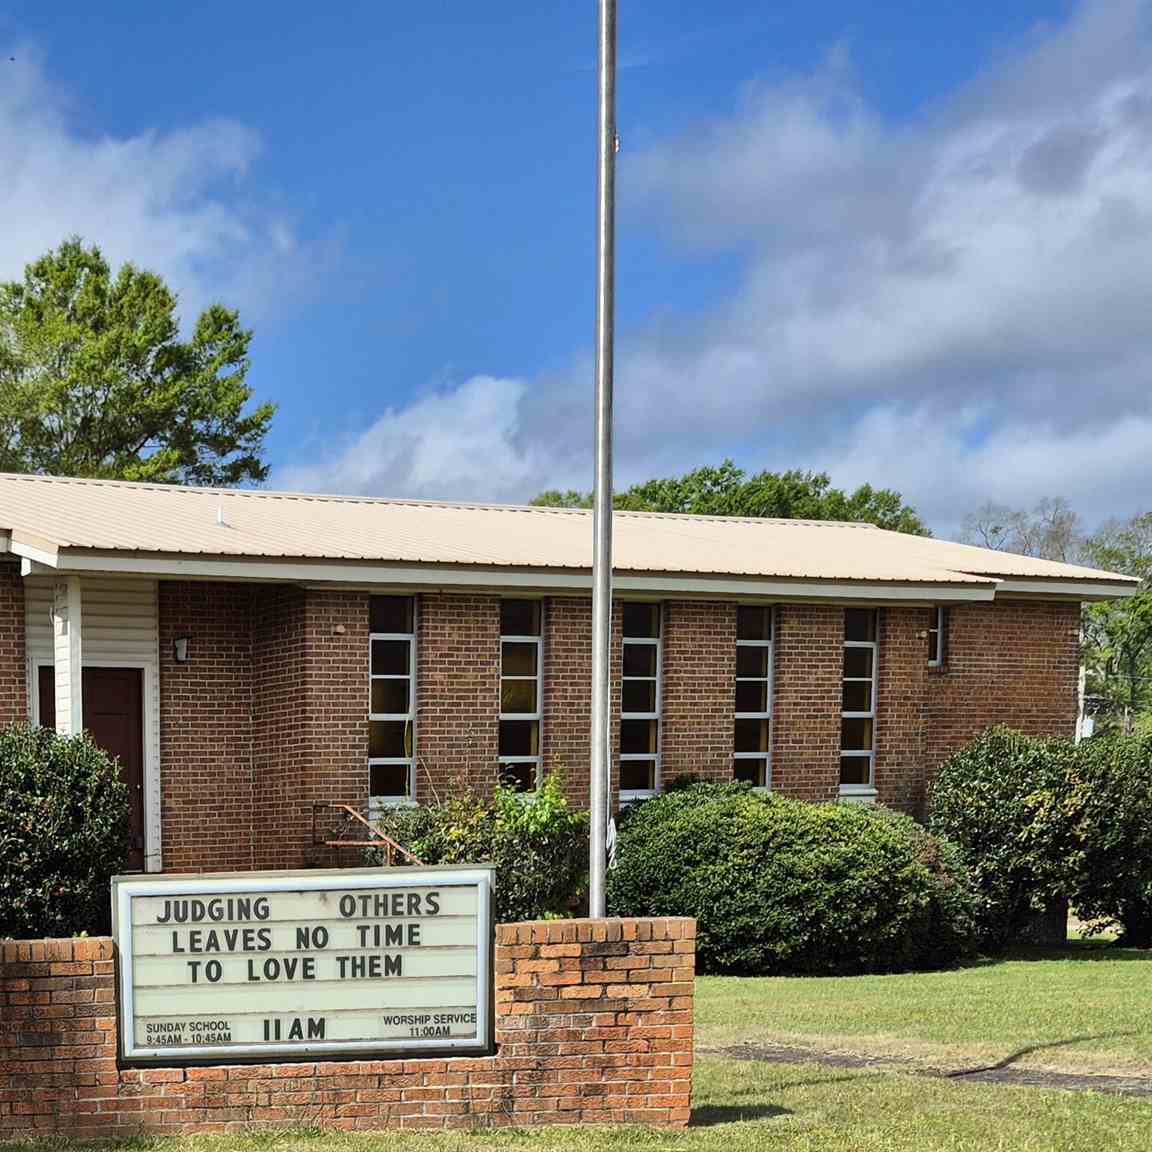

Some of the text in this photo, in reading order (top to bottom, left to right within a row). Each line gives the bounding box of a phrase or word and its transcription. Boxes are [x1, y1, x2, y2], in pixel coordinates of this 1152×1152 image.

[156, 891, 441, 923] JUDGING OTHERS
[173, 924, 421, 953] LEAVES NO TIME
[188, 954, 403, 983] TO LOVE THEM
[146, 1020, 231, 1033] SUNDAY SCHOOL
[383, 1013, 477, 1025] WORSHIP SERVICE
[409, 1026, 451, 1037] 11:00AM
